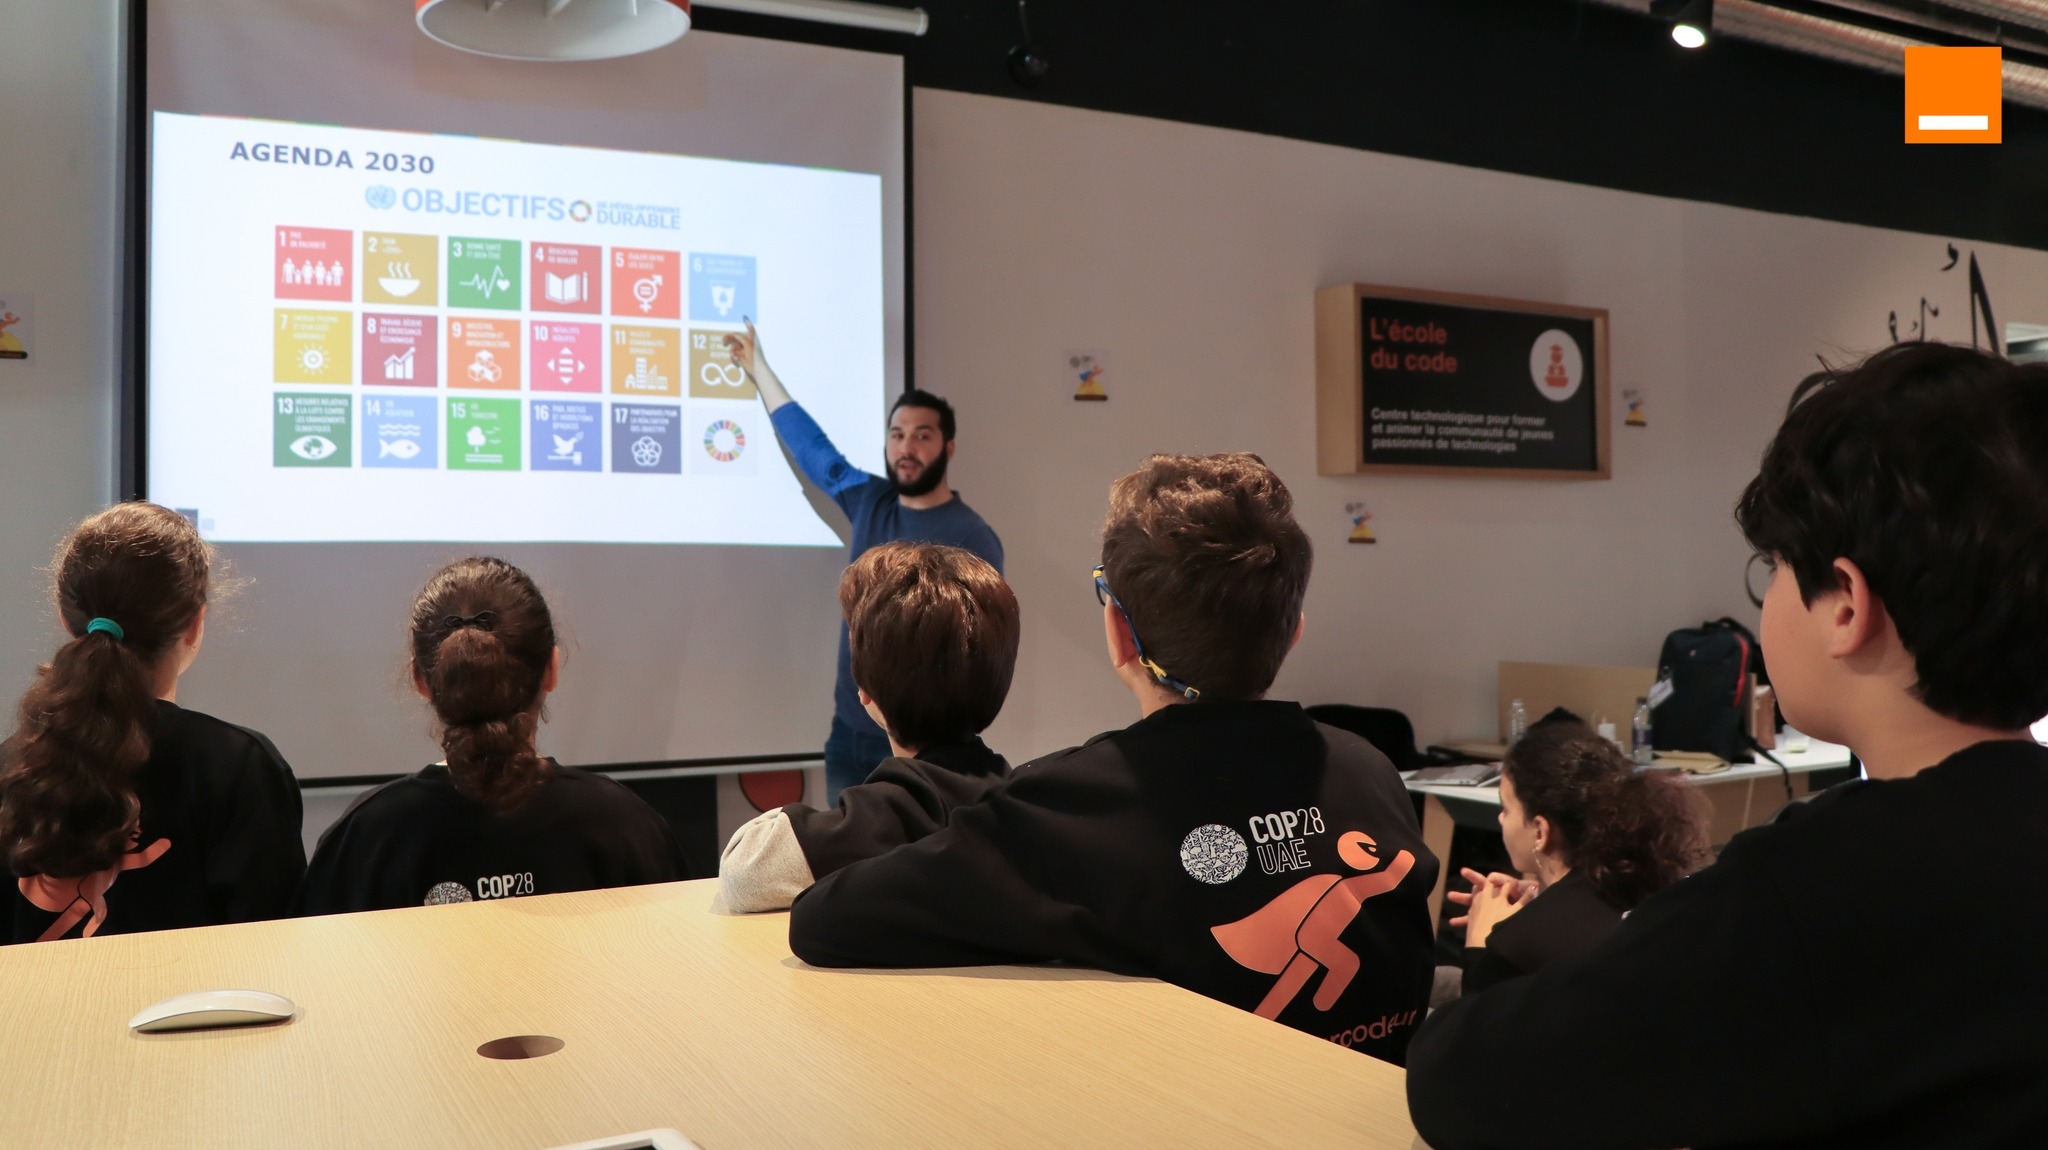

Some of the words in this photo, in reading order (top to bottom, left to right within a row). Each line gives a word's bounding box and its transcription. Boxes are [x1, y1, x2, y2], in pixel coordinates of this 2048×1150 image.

[230, 141, 354, 169] AGENDA
[364, 151, 435, 174] 2030
[402, 187, 566, 222] OBJECTIFS
[597, 209, 681, 230] DURABLE
[279, 231, 286, 247] 1
[367, 236, 378, 253] 2
[452, 241, 463, 258] 3
[534, 246, 544, 263] 4
[615, 251, 625, 268] 5
[693, 257, 703, 273] 6
[280, 313, 289, 330] 7
[367, 317, 377, 334] 8
[452, 321, 462, 338] 9
[534, 325, 549, 341] 10
[615, 329, 626, 345] 11
[1370, 317, 1447, 345] L'école
[692, 334, 707, 349] 12
[1370, 347, 1398, 369] du
[1404, 350, 1457, 374] code
[277, 397, 294, 414] 13
[366, 399, 381, 417] 14
[450, 402, 466, 419] 15
[534, 404, 549, 421] 16
[615, 407, 628, 424] 17
[1371, 407, 1408, 420] Centre
[1410, 409, 1485, 424] technologique
[1486, 414, 1510, 426] pour
[1371, 423, 1383, 434] et
[1505, 427, 1519, 438] de
[1435, 438, 1449, 449] de
[1450, 438, 1518, 454] technologies
[1249, 806, 1326, 844] COP28
[1256, 838, 1311, 875] UAE
[476, 871, 534, 899] COP28
